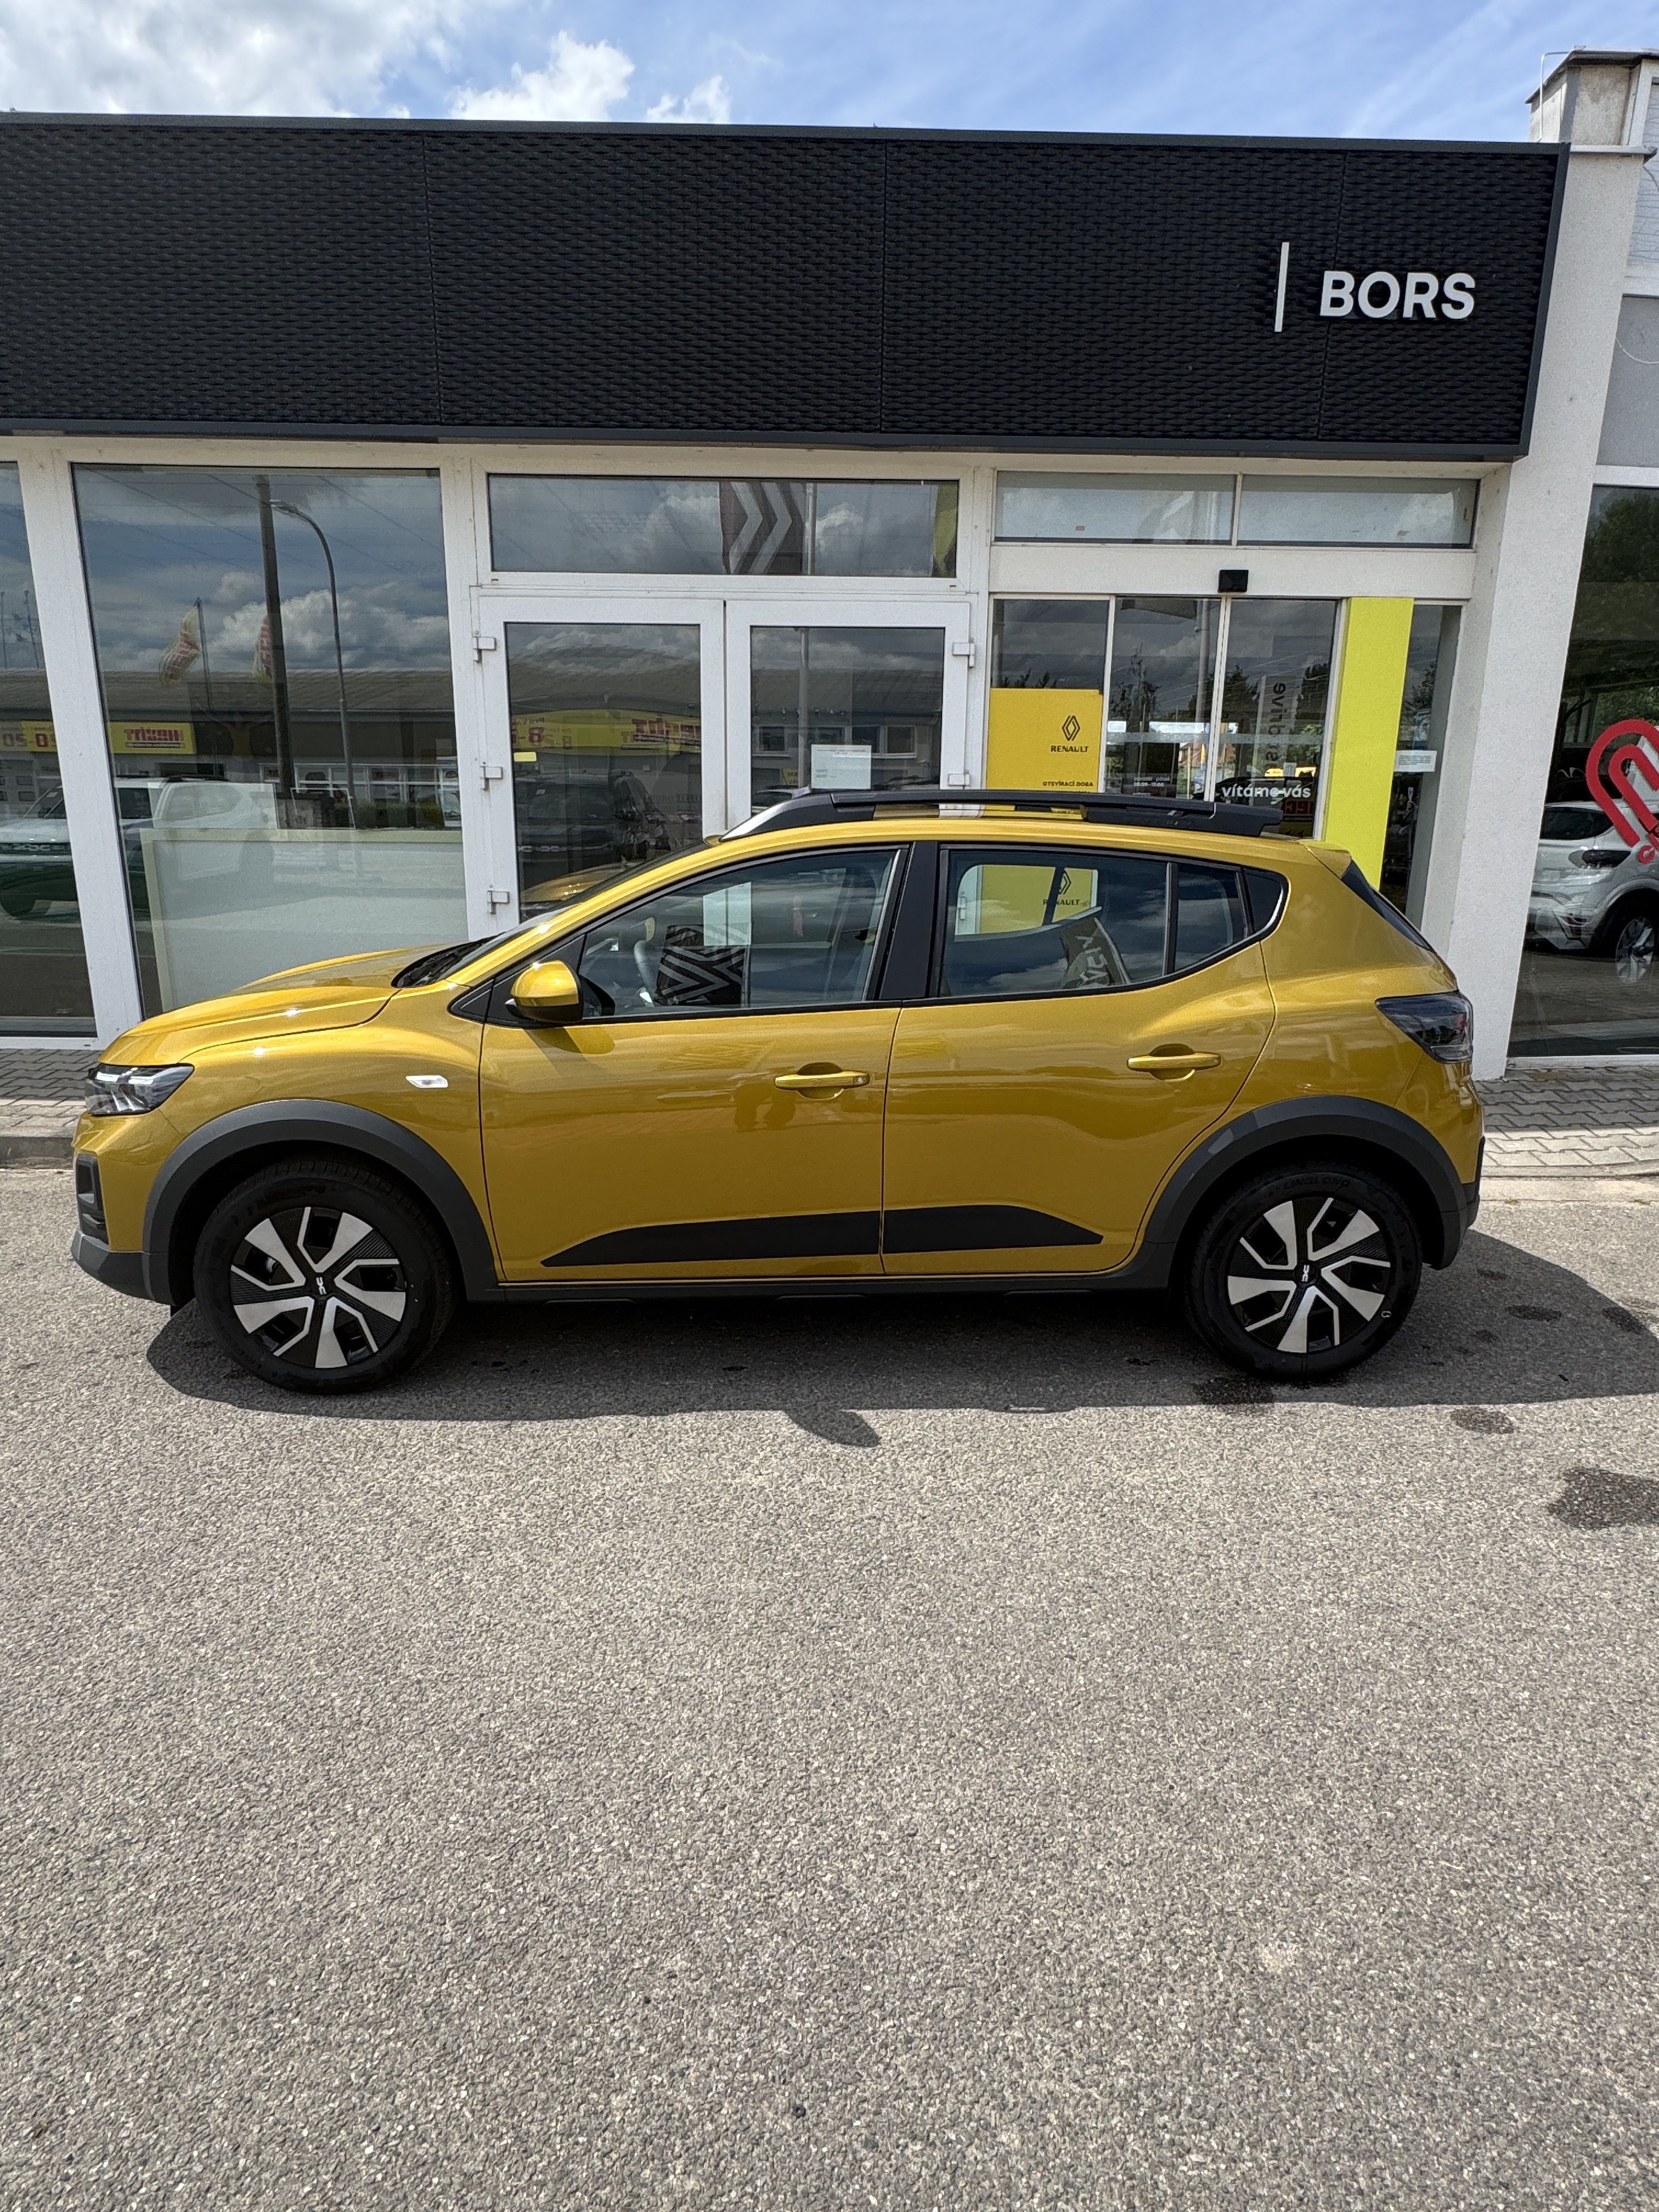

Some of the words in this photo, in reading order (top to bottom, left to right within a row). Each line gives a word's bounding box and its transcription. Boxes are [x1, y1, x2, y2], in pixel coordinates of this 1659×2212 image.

[1319, 270, 1476, 319] BORS
[1222, 783, 1279, 798] vítáme
[1281, 783, 1311, 798] vás
